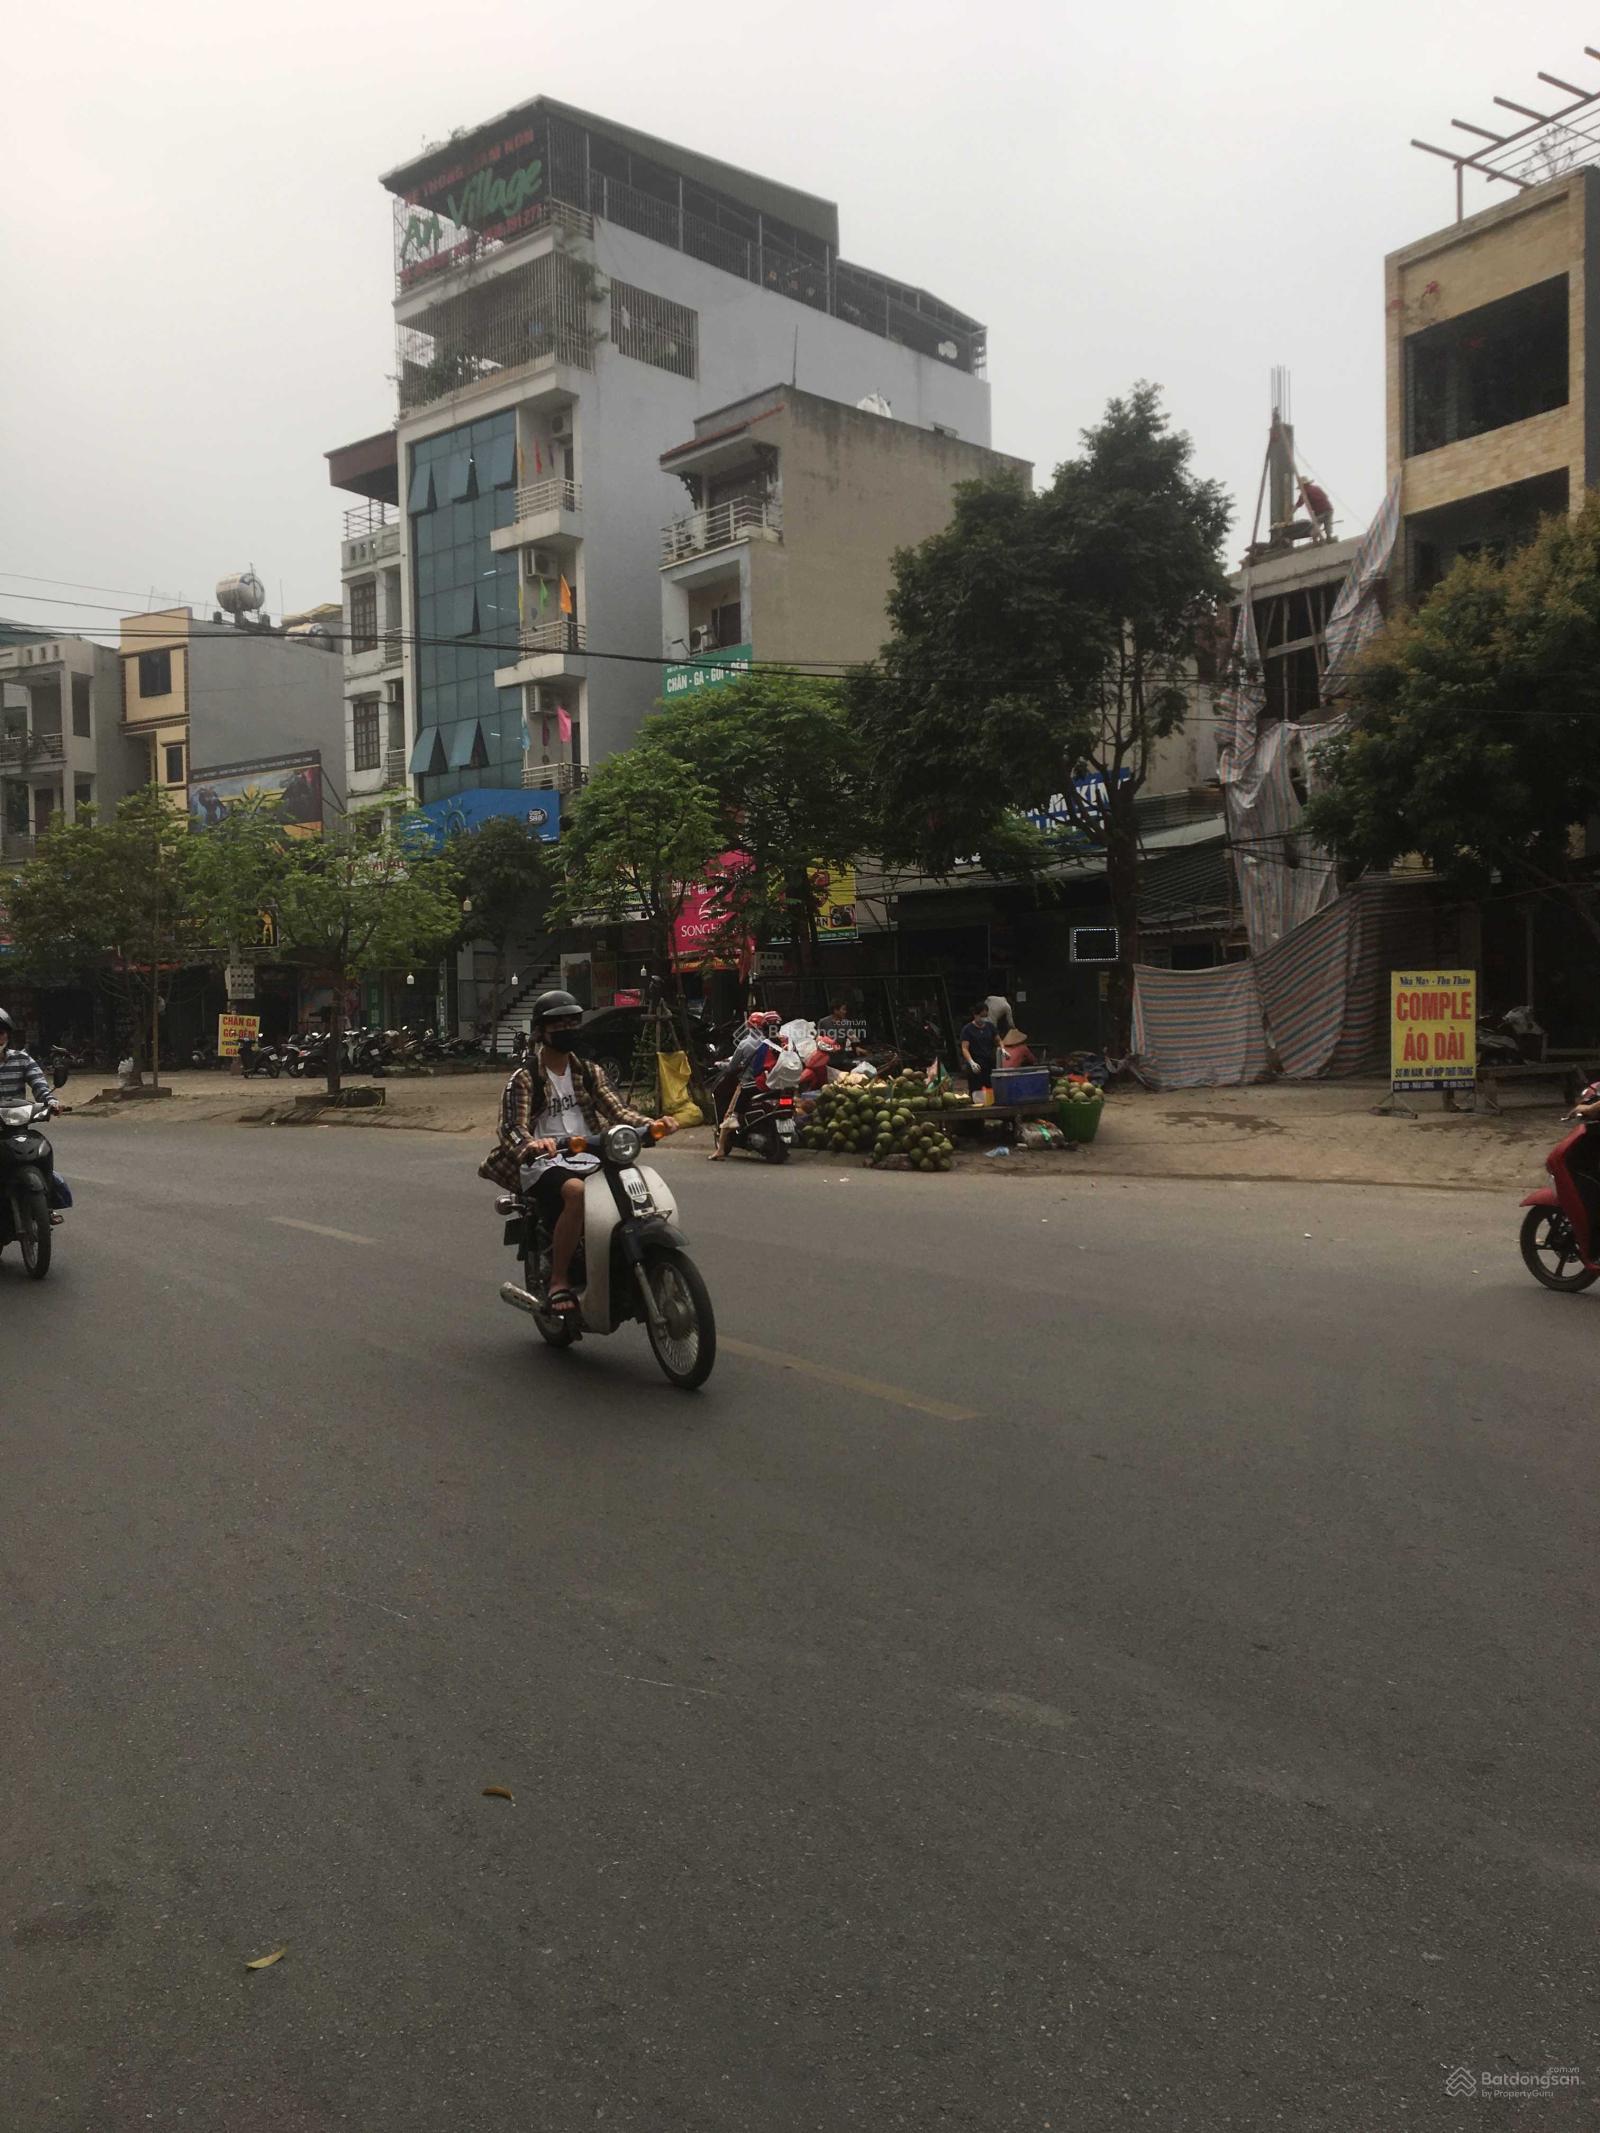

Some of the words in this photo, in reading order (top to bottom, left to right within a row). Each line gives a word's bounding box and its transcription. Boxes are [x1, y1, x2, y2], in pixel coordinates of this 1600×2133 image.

[446, 159, 542, 231] Village
[693, 670, 705, 686] GA
[1396, 991, 1472, 1021] COMPLE
[246, 1018, 257, 1027] GA
[1403, 1027, 1429, 1061] ÁO
[1434, 1026, 1465, 1061] DÀI
